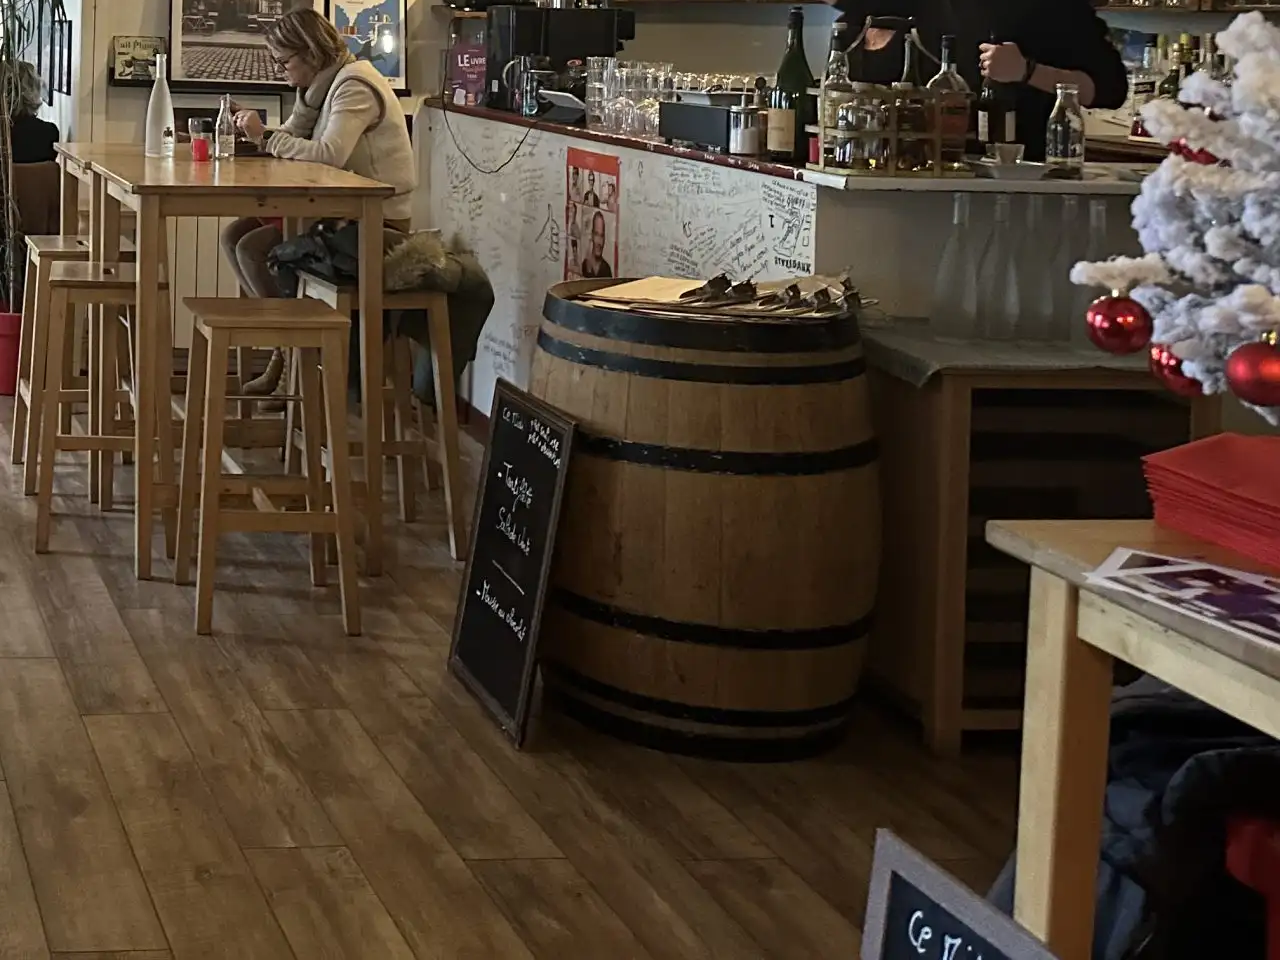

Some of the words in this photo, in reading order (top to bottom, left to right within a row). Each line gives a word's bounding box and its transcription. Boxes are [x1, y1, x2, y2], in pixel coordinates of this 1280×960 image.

[457, 54, 470, 67] LE
[470, 57, 486, 65] LIVRE
[908, 910, 933, 954] Ce
